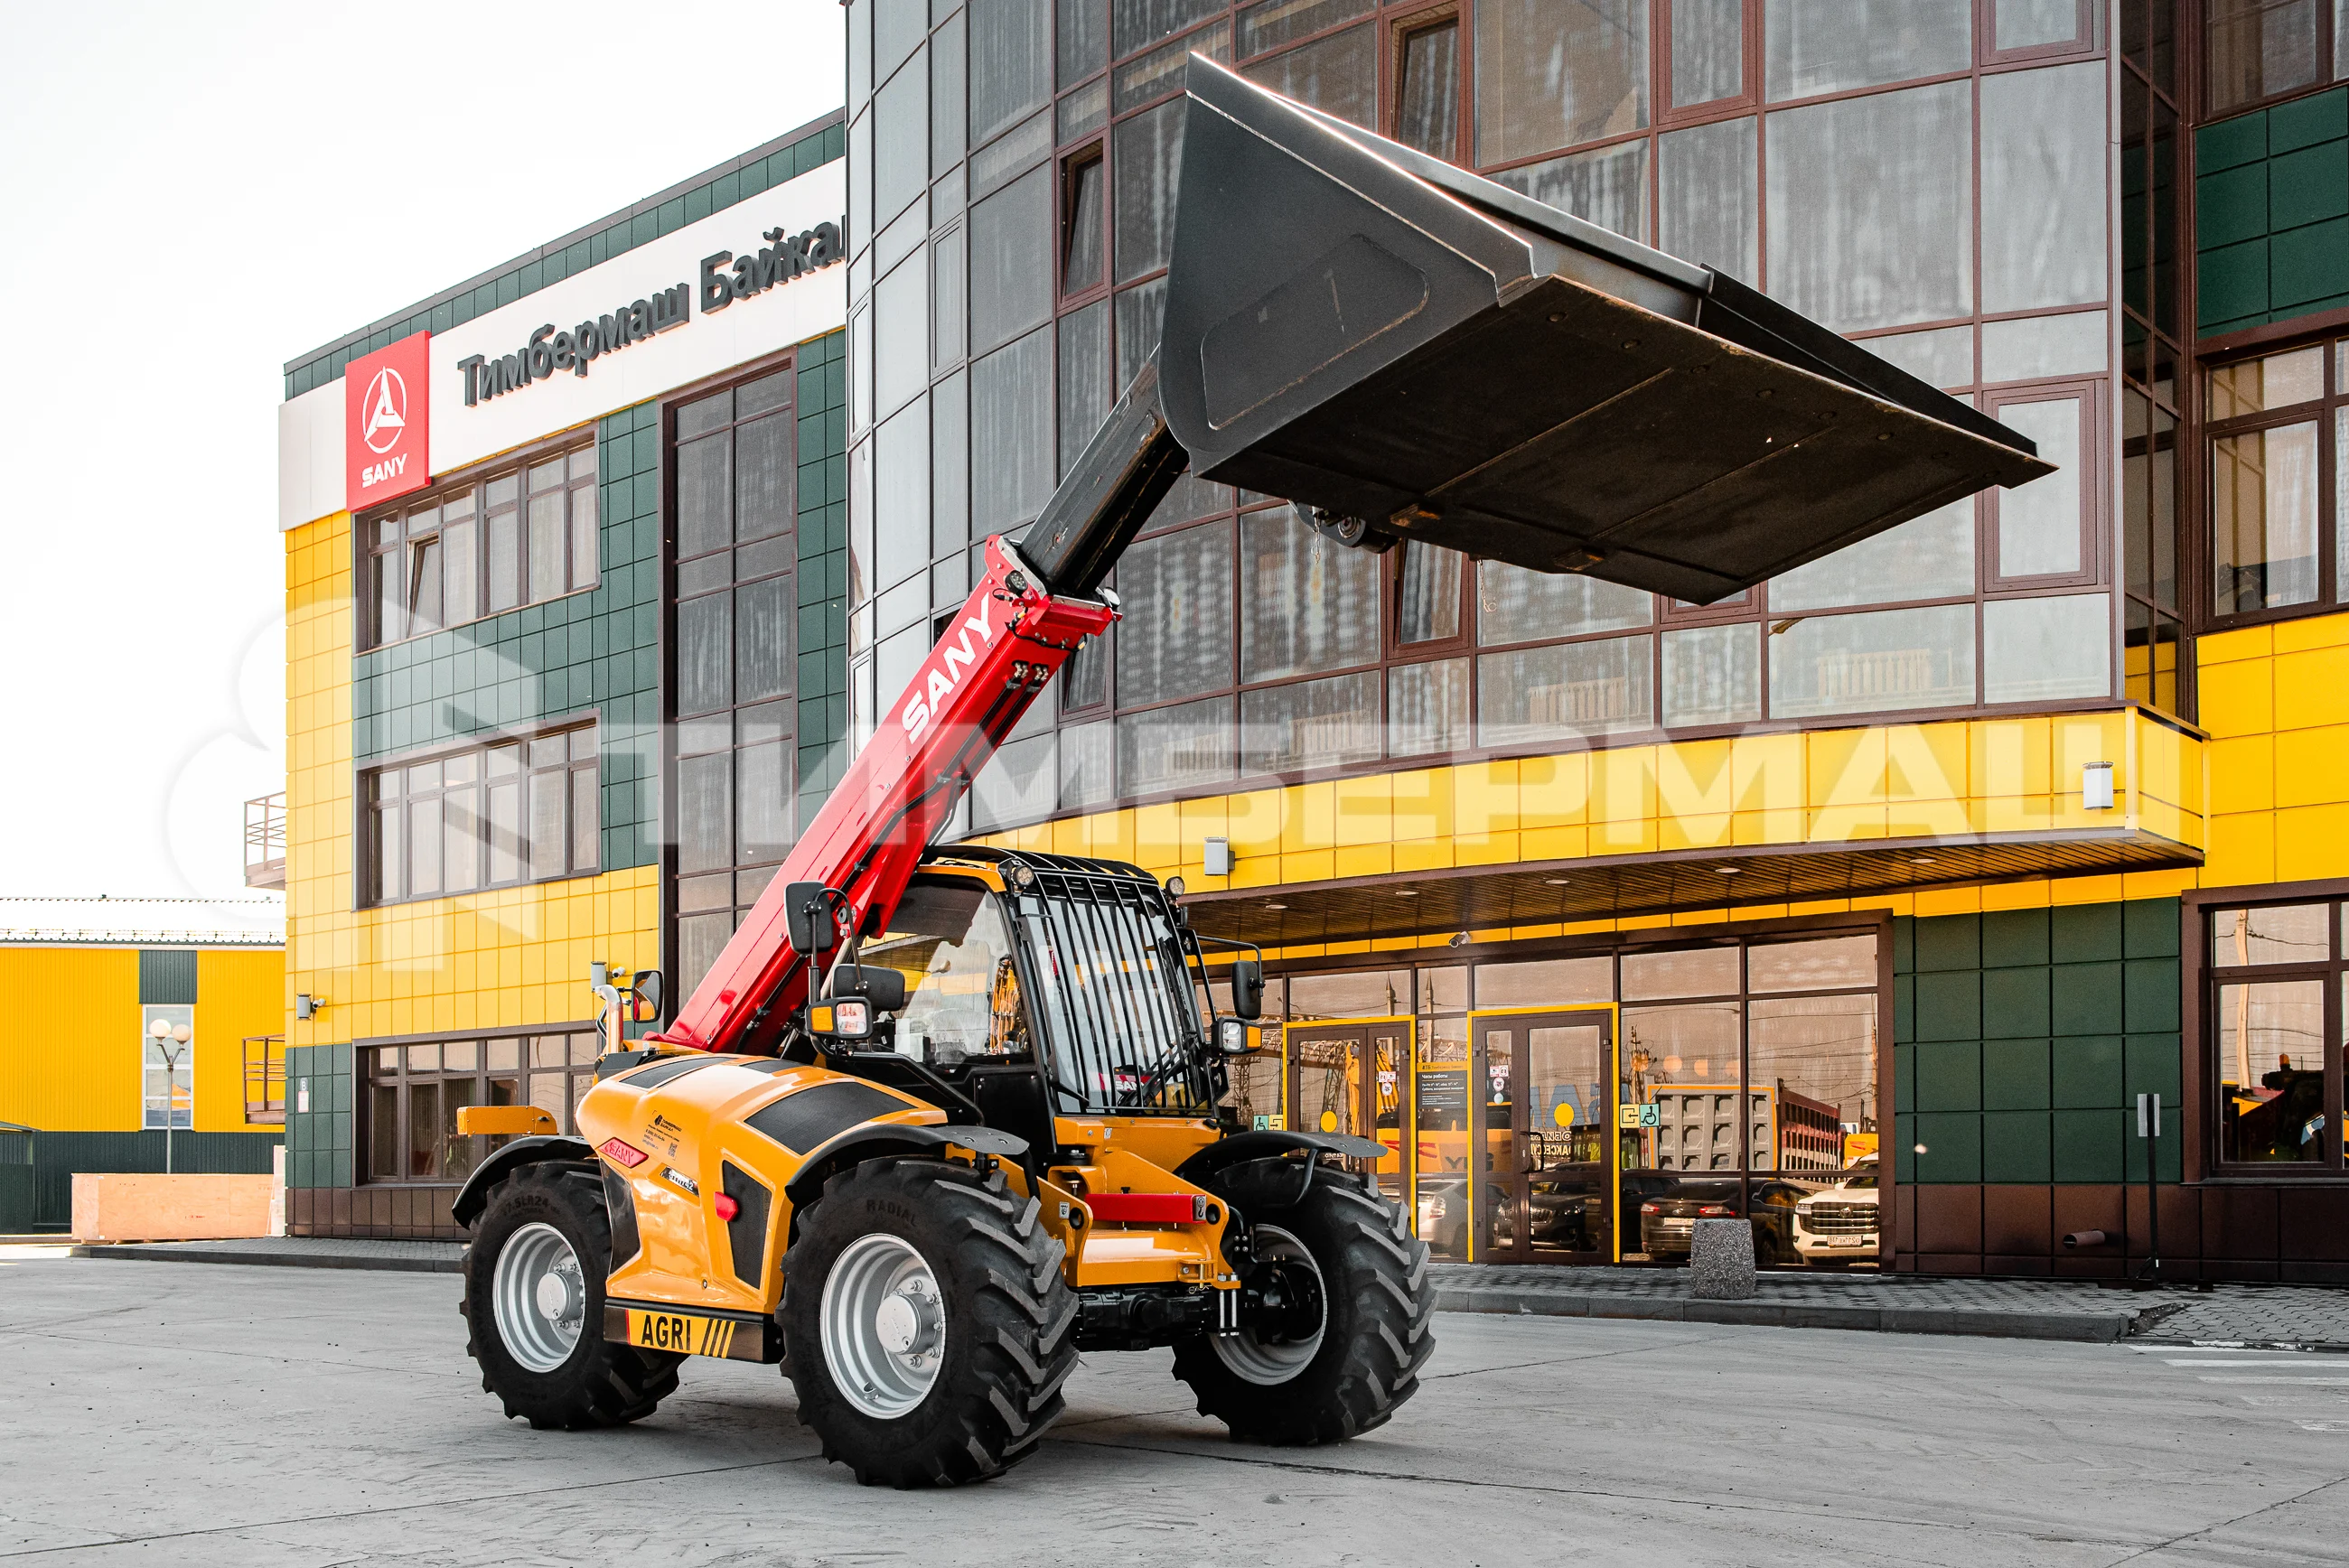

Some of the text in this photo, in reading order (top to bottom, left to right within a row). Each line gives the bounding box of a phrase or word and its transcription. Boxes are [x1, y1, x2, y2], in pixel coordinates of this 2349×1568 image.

[457, 215, 847, 407] Тимбермаш Байка
[361, 453, 407, 489] SANY
[902, 592, 993, 744] SANY
[607, 1141, 635, 1165] SANY
[866, 1199, 917, 1227] RADIAL
[641, 1314, 691, 1351] AGRI
